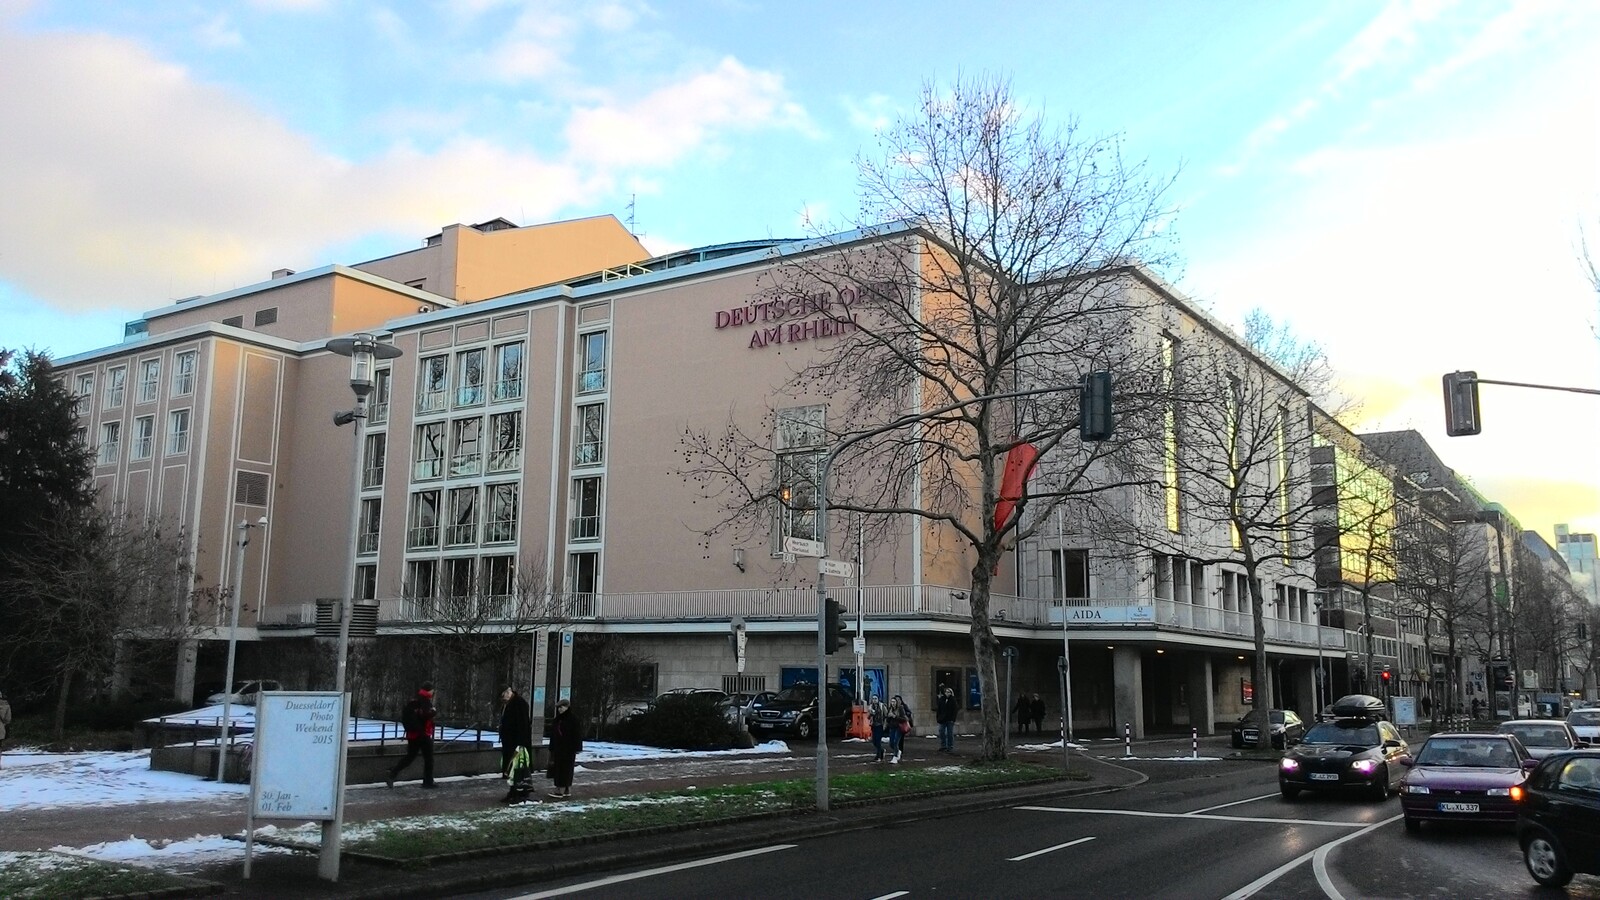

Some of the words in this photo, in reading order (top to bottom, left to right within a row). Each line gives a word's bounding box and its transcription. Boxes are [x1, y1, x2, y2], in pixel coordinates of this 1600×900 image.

[715, 291, 832, 329] DEUTSCHE
[748, 325, 783, 349] AM
[1073, 610, 1102, 619] AIDA
[285, 700, 337, 710] Duesseldorf
[310, 712, 335, 721] Photo
[295, 723, 334, 733] Weekend
[312, 735, 334, 744] 2015
[261, 791, 274, 801] 30.
[275, 791, 292, 802] Jan
[261, 802, 274, 811] 01.
[276, 802, 292, 812] Feb
